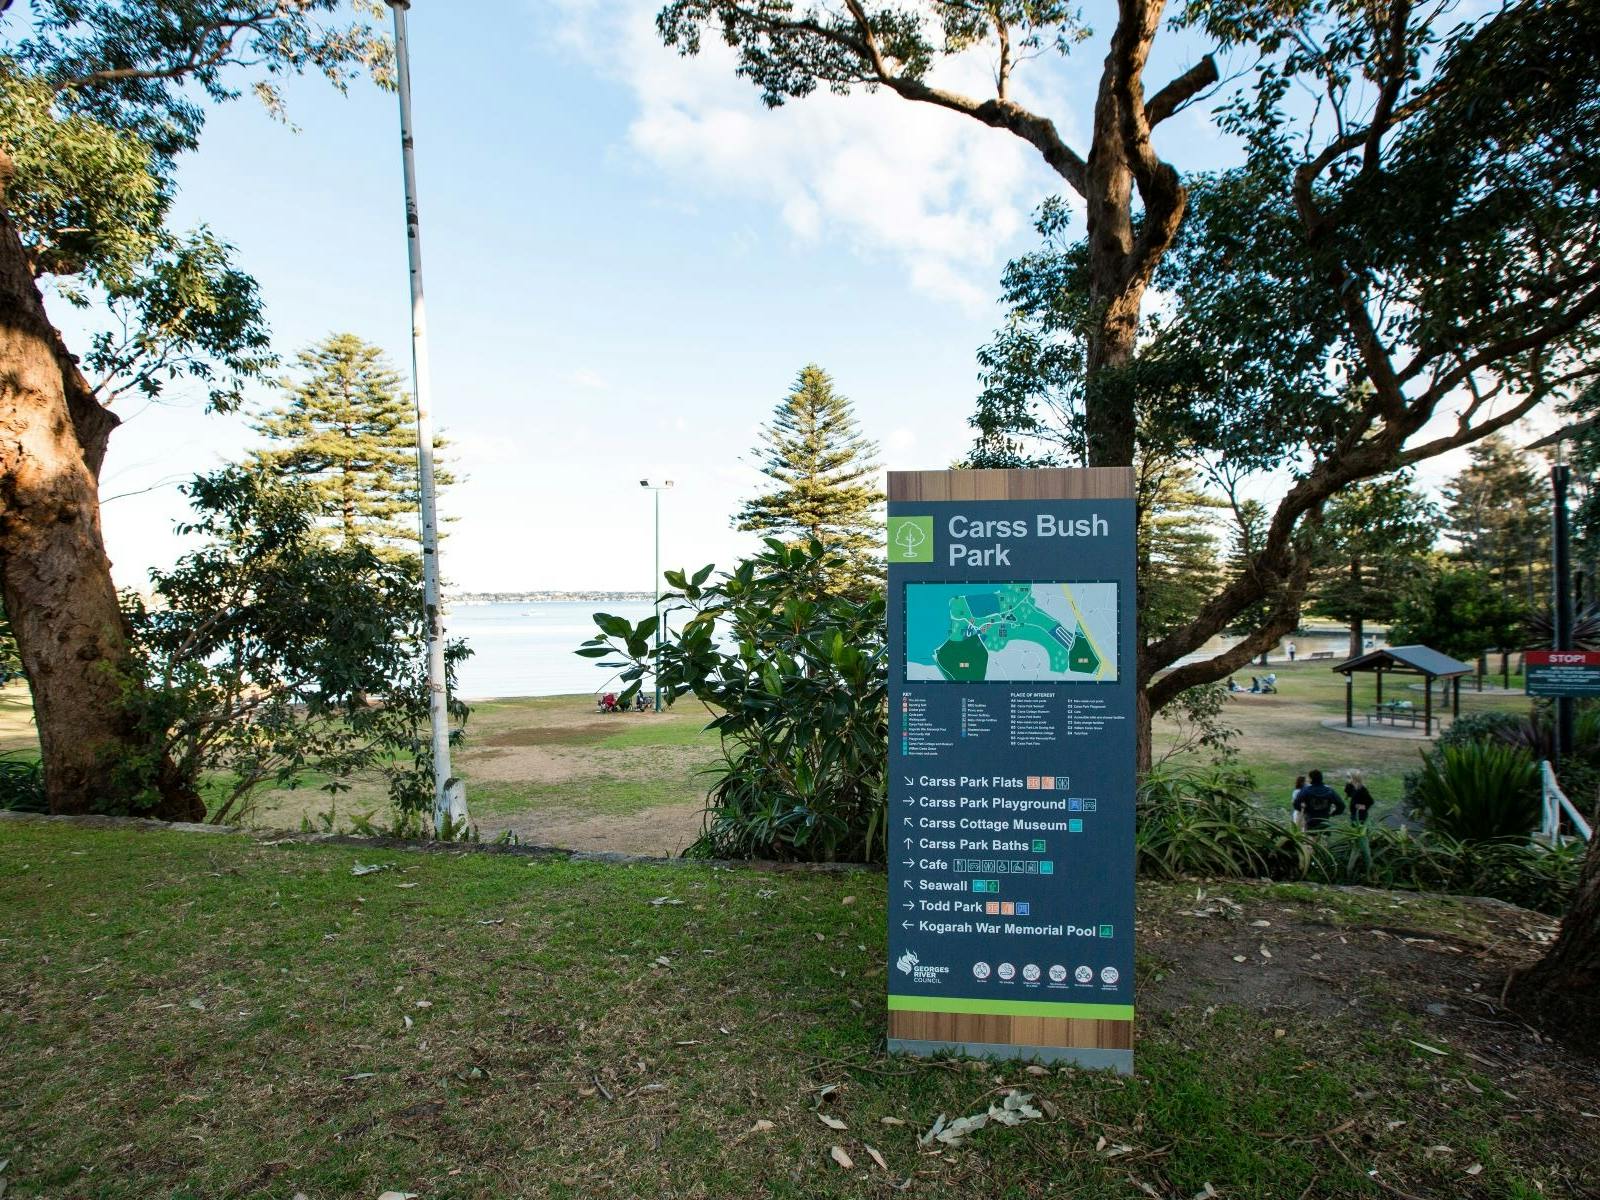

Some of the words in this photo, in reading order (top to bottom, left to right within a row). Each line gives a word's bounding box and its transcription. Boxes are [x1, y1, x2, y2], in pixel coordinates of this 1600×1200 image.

[948, 515, 1028, 539] Carss
[1036, 514, 1109, 537] Bush
[949, 543, 1011, 567] Park
[1548, 654, 1586, 663] STOP!
[919, 776, 956, 787] Carss
[960, 777, 988, 788] Park
[992, 777, 1024, 788] Flats
[919, 797, 956, 808] Carss
[960, 797, 988, 808] Park
[992, 798, 1066, 811] Playground
[919, 818, 956, 829] Carss
[960, 819, 1009, 832] Cottage
[1013, 819, 1067, 831] Museum
[919, 838, 956, 849] Carss
[960, 839, 988, 850] Park
[992, 840, 1029, 852] Baths
[919, 859, 948, 870] Cafe
[919, 880, 968, 891] Seawall
[919, 900, 950, 912] Todd
[954, 901, 983, 912] Park
[919, 921, 972, 935] Kogarah
[976, 922, 1001, 933] War
[1004, 923, 1063, 936] Memorial
[1067, 926, 1097, 937] Pool
